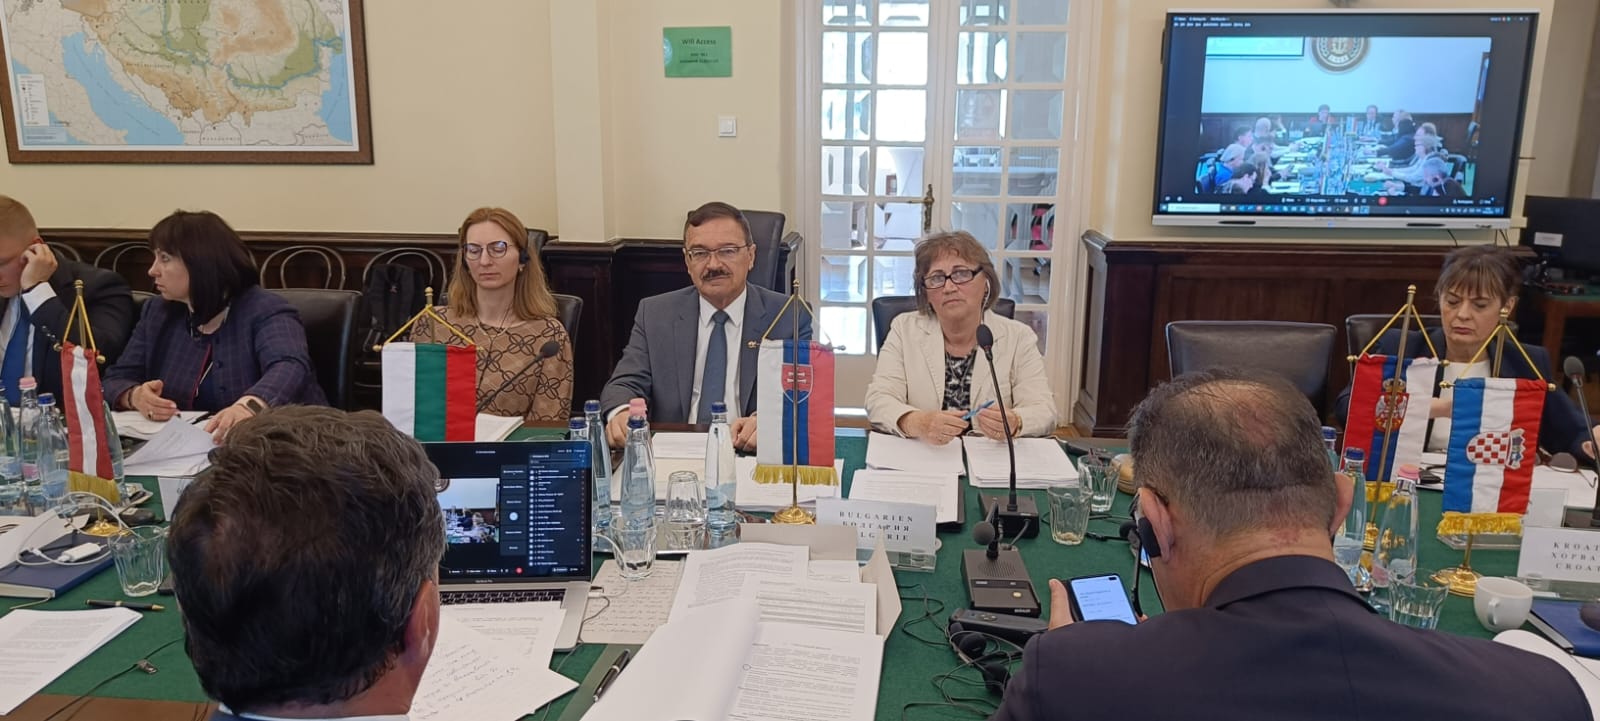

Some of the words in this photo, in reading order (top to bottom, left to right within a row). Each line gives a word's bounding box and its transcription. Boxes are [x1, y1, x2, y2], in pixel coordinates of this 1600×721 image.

[839, 511, 913, 522] BULGARIEN
[842, 521, 909, 532] БОЛГАРИЯ
[860, 531, 909, 541] LGRIE
[1553, 541, 1600, 551] KROAT
